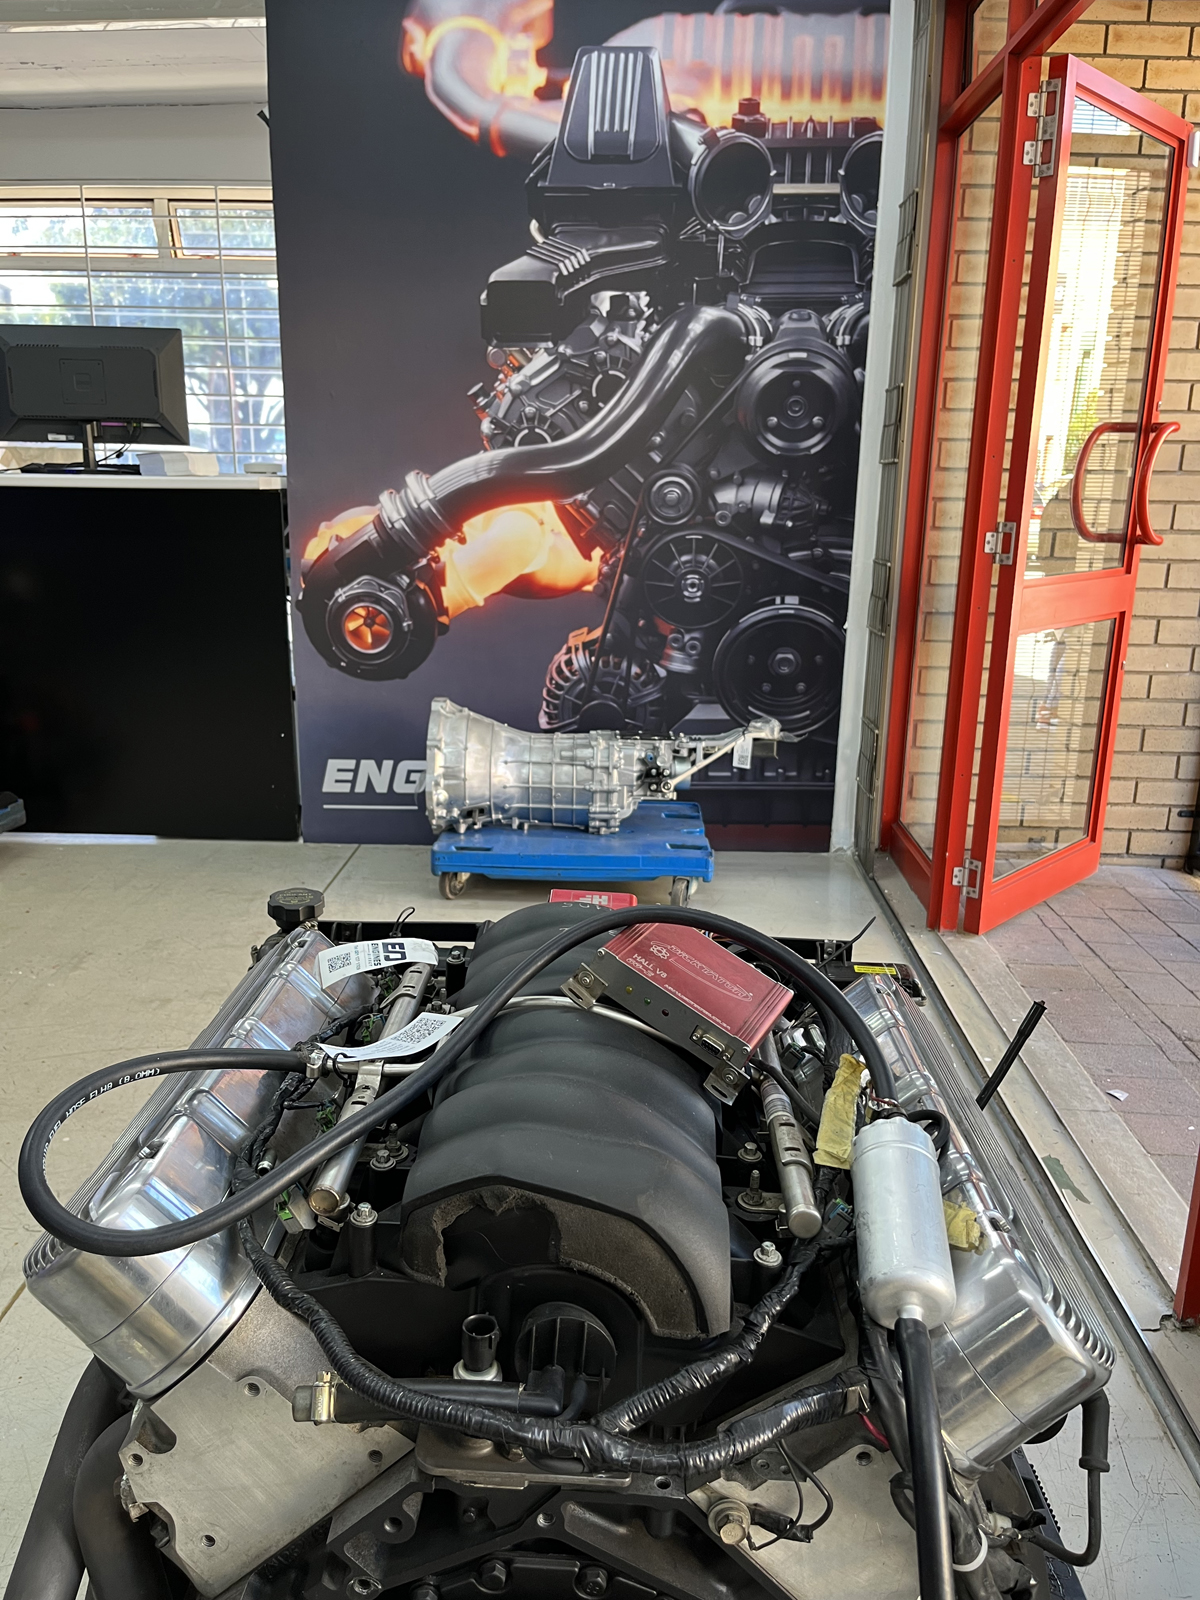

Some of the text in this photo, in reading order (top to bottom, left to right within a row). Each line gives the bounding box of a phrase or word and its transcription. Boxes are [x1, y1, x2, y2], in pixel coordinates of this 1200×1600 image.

[322, 758, 427, 793] ENG
[371, 943, 381, 967] ENGINES
[632, 953, 668, 979] HALL V8
